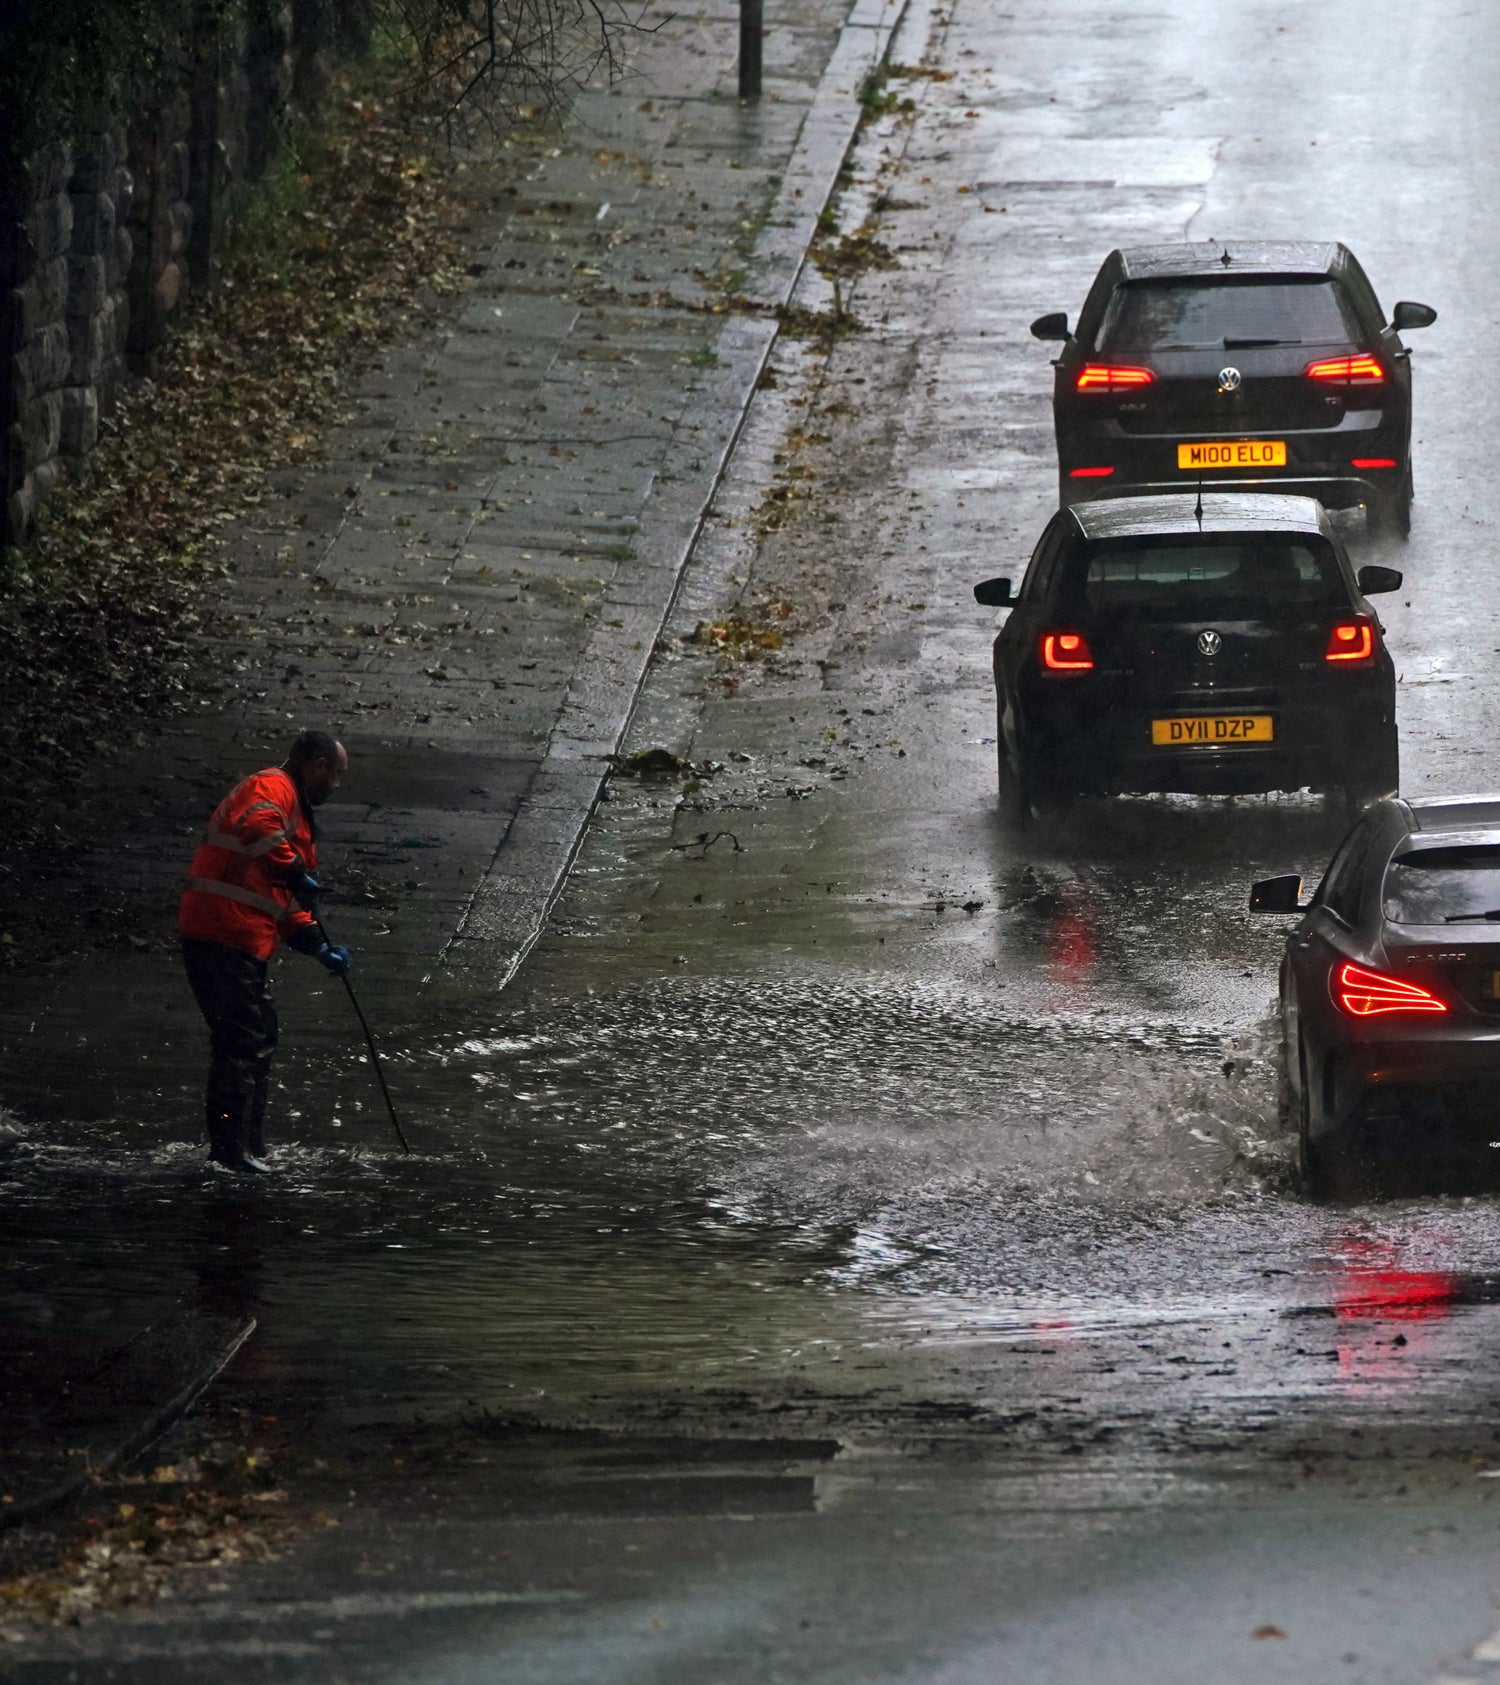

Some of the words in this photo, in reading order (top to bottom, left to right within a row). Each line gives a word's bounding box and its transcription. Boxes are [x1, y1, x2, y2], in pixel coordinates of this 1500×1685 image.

[1190, 446, 1231, 464] M100
[1237, 445, 1273, 462] ELO
[1169, 720, 1209, 740] DY11
[1214, 719, 1255, 738] DZP
